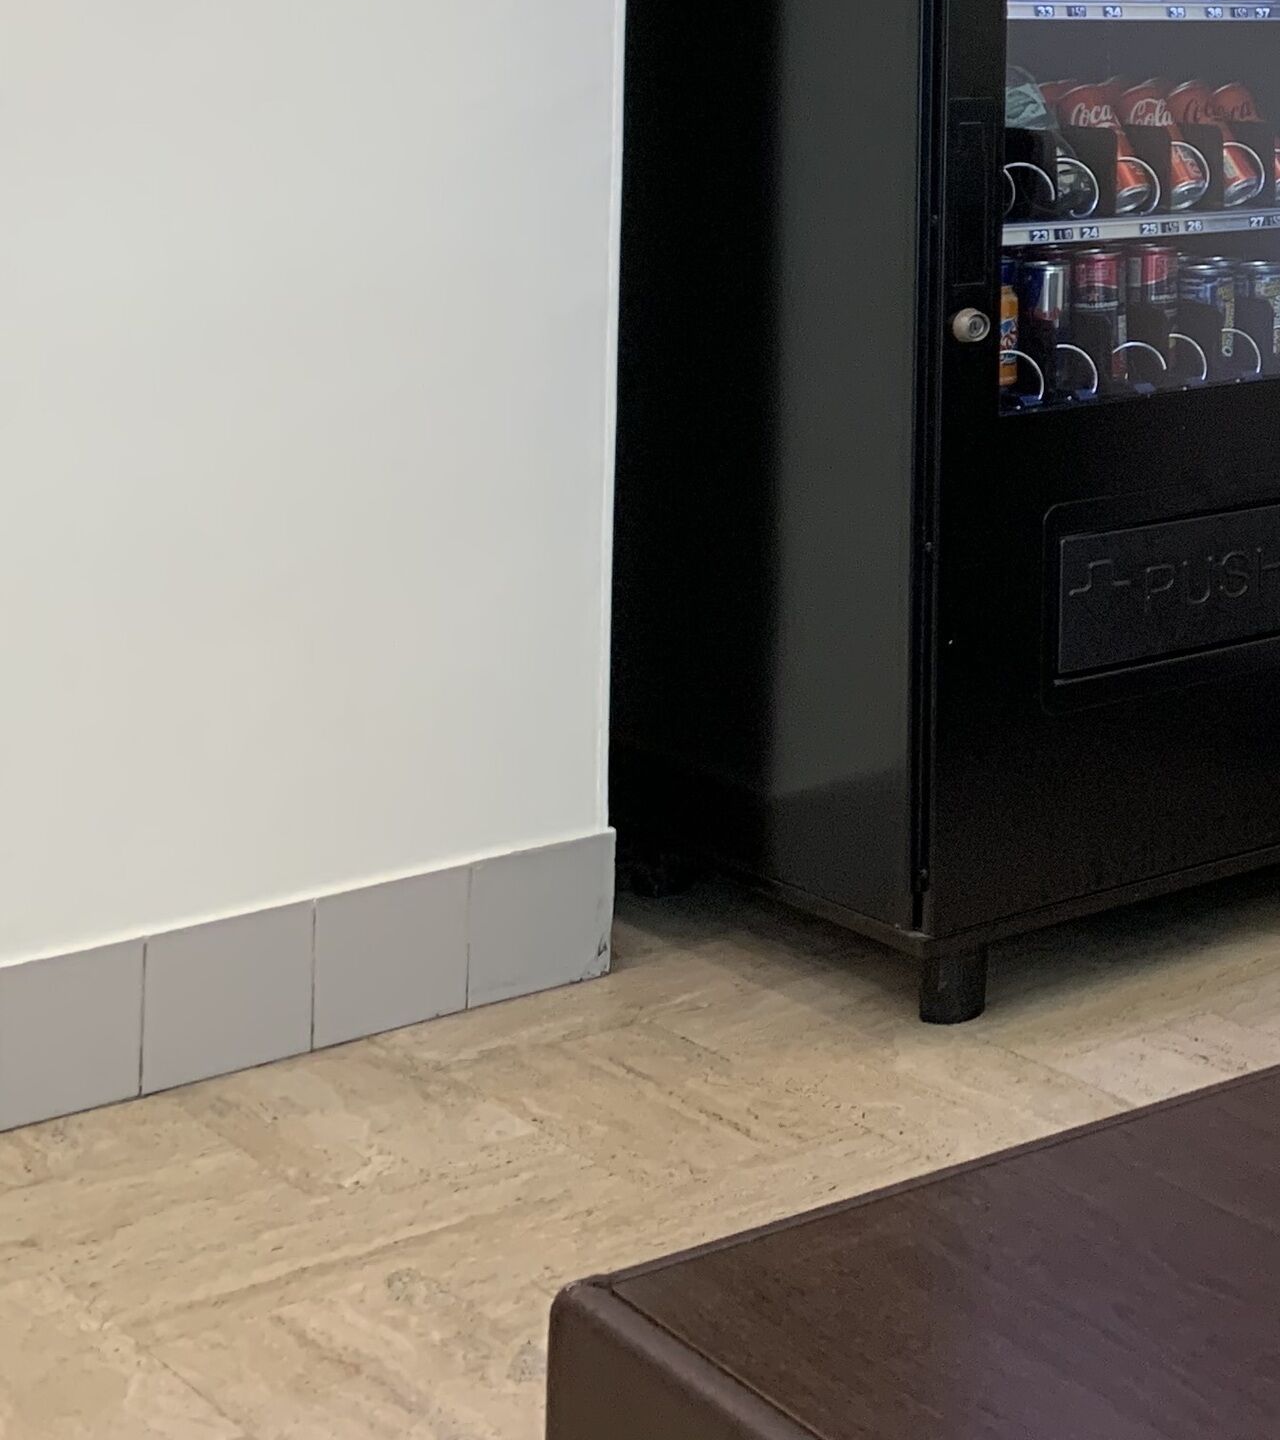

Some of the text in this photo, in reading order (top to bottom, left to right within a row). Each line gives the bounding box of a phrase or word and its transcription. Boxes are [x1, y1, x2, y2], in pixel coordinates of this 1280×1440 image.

[1037, 7, 1053, 17] 33
[1105, 7, 1122, 17] 34
[1256, 8, 1270, 18] 37
[1070, 102, 1113, 127] Coca
[1130, 99, 1174, 127] Cola
[1032, 231, 1048, 241] 23
[1083, 227, 1098, 238] 24
[1142, 224, 1157, 234] 25
[1187, 221, 1202, 232] 26
[1250, 216, 1265, 227] 27
